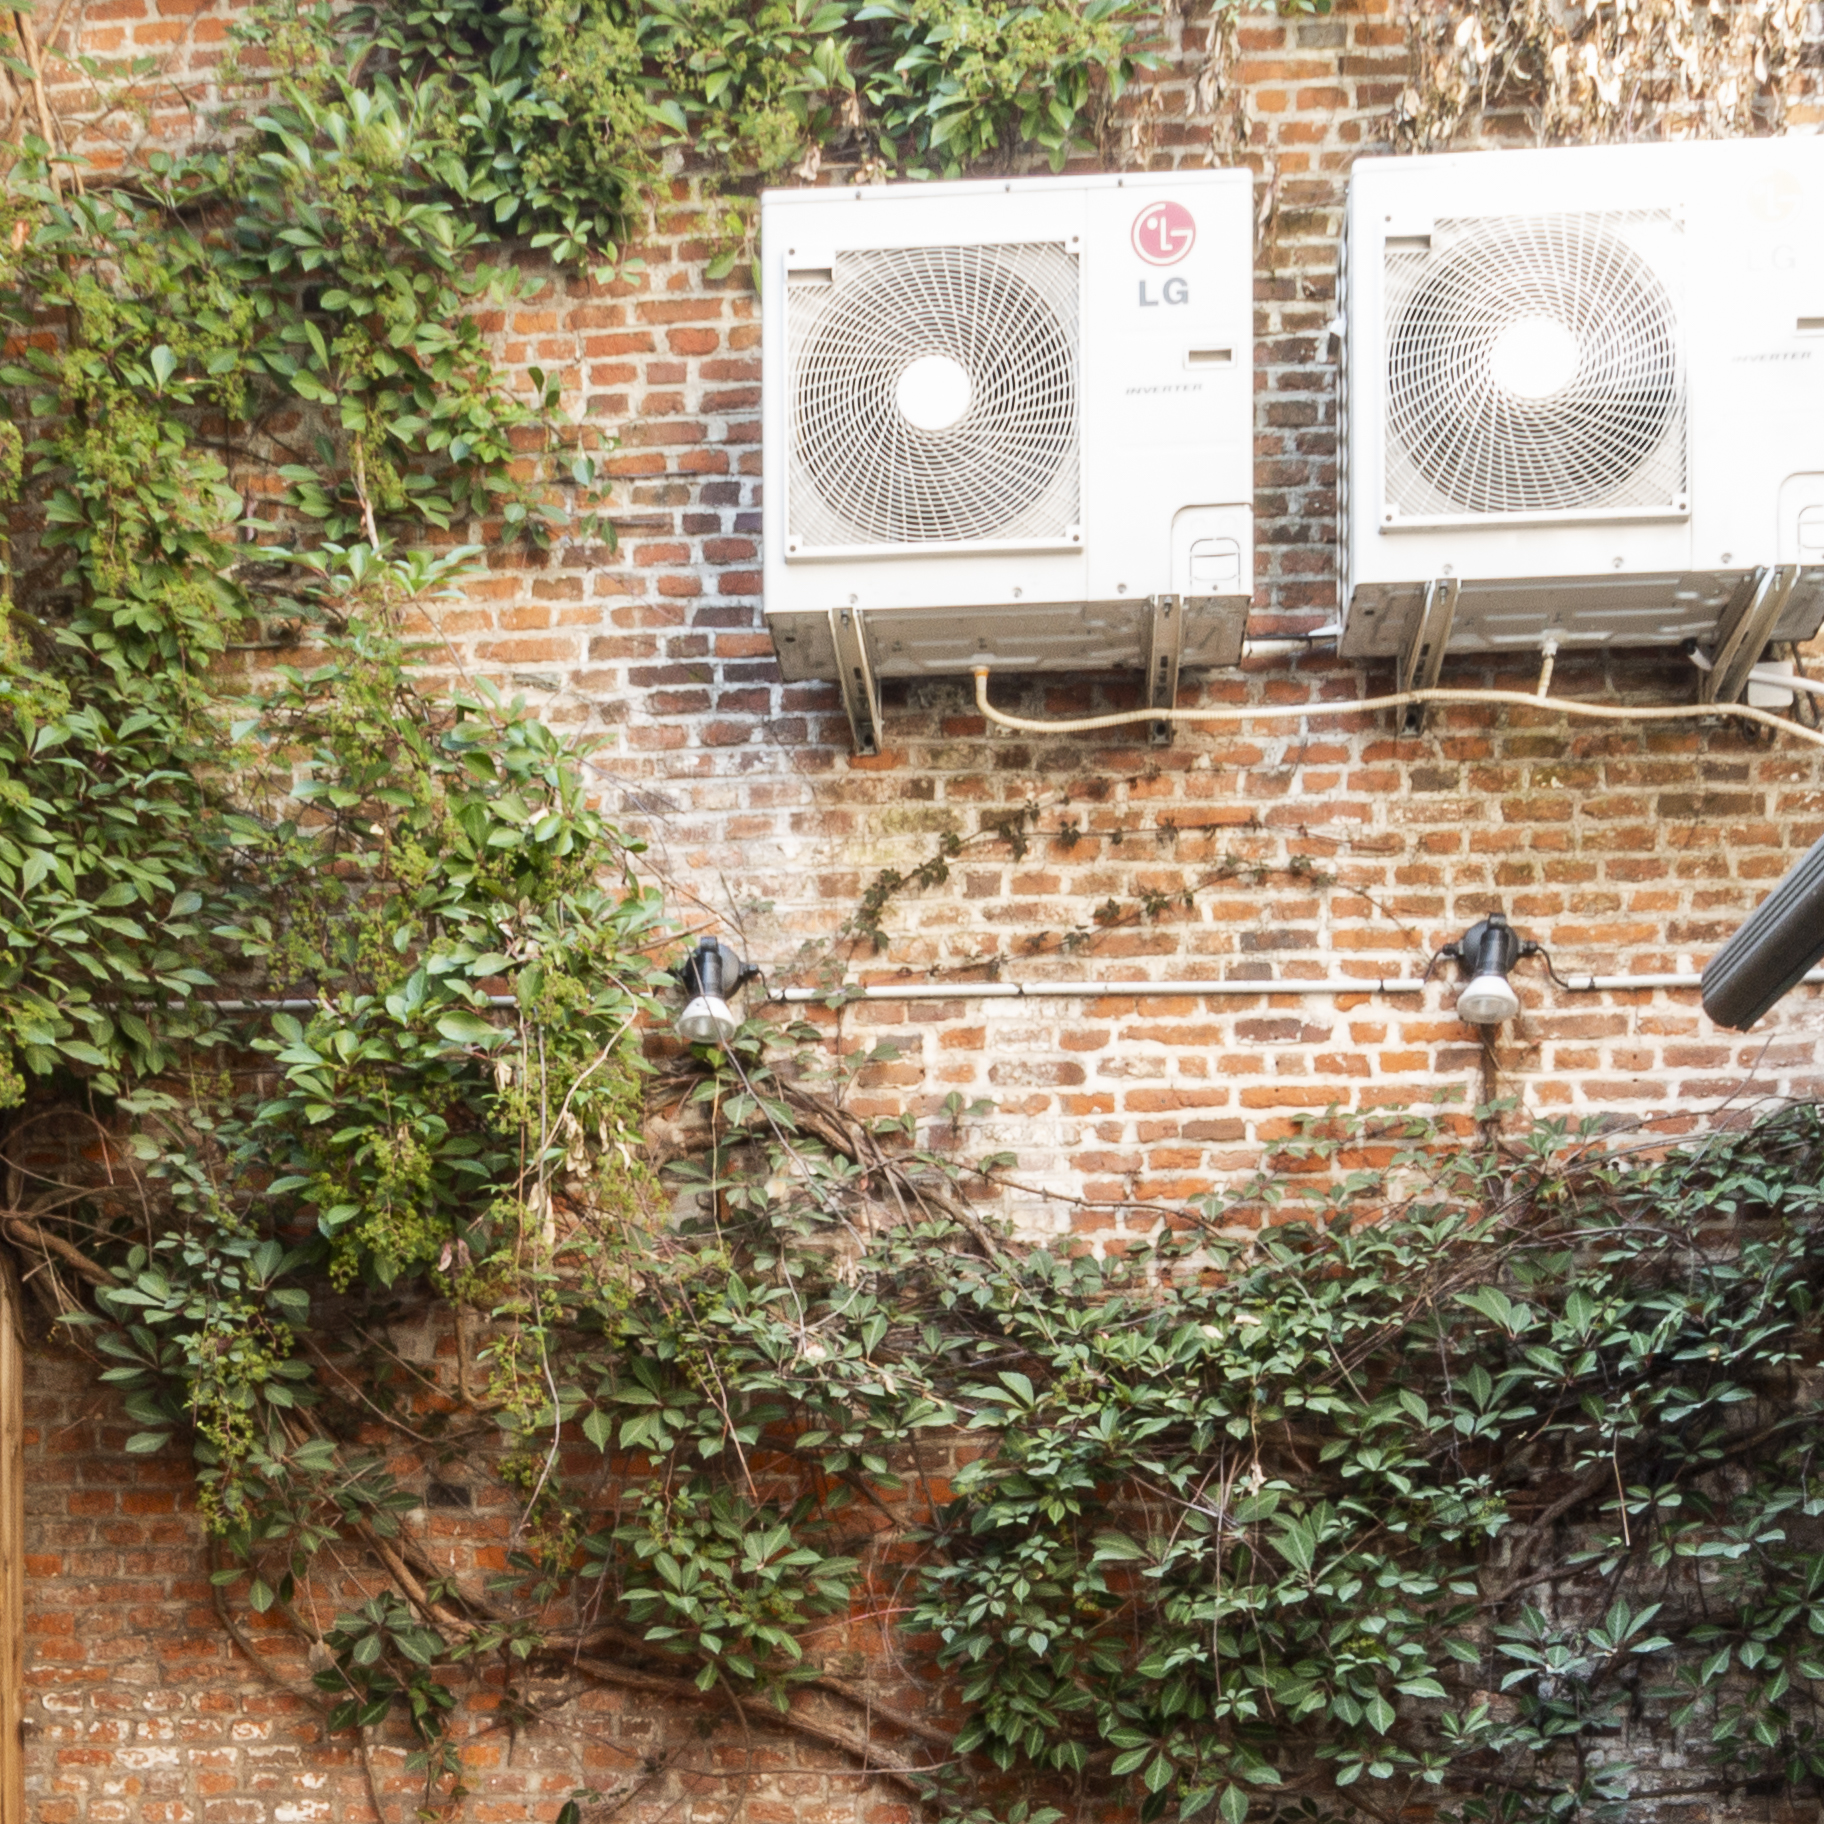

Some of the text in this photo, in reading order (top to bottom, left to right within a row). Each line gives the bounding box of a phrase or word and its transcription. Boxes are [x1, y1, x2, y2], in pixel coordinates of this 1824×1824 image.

[1139, 277, 1189, 306] LG
[1731, 351, 1812, 363] INVERTER
[1125, 382, 1203, 395] INVERTER
